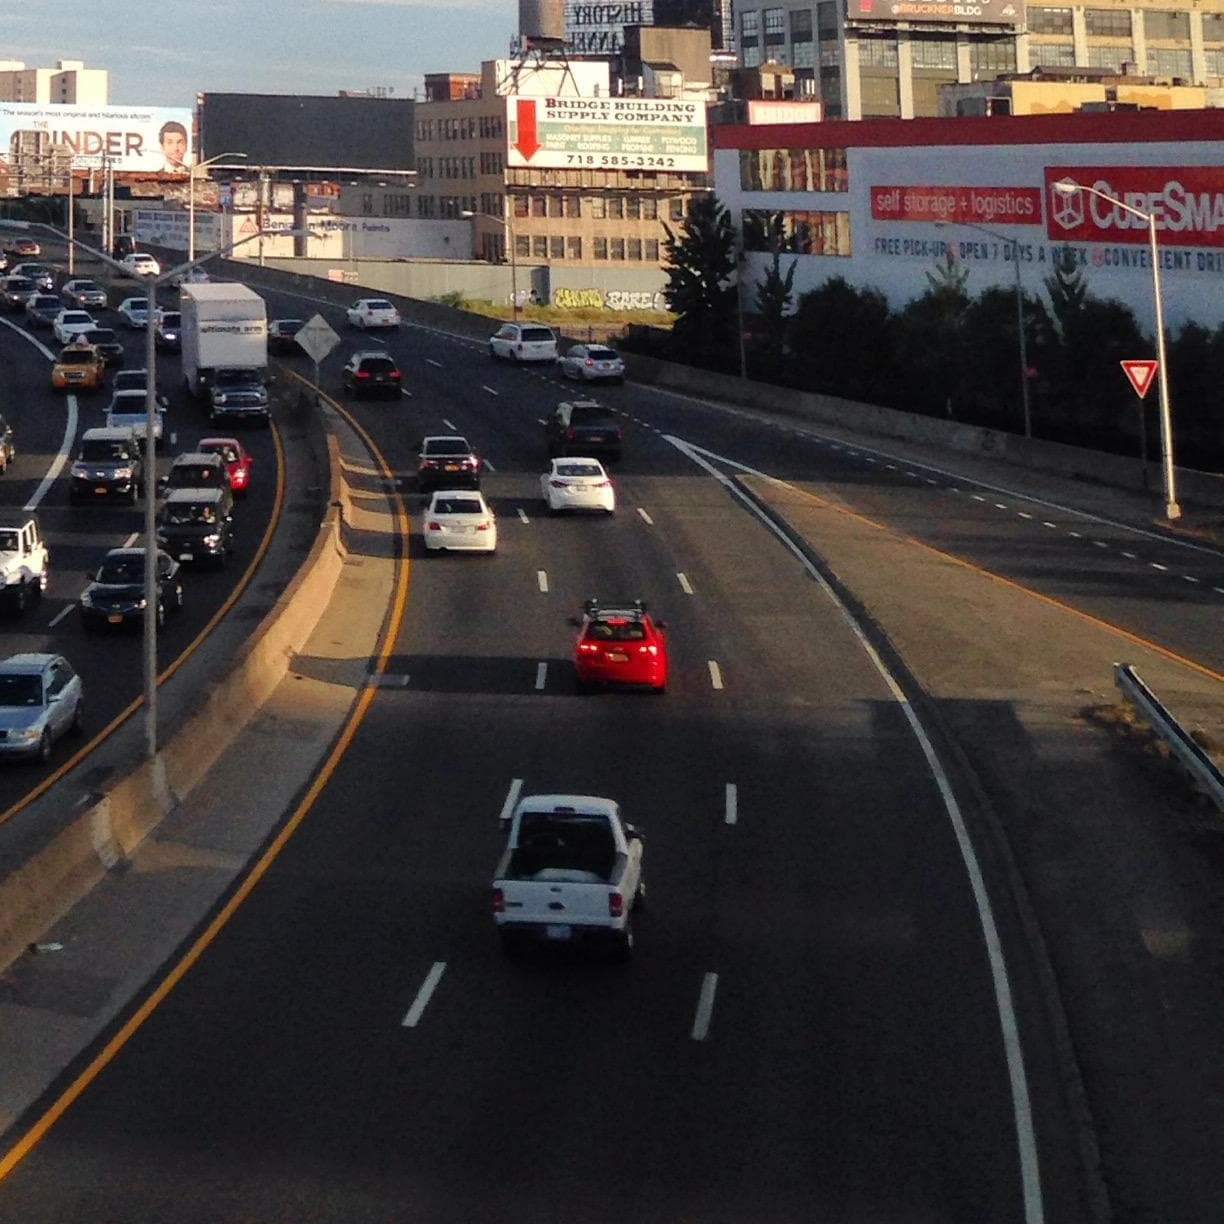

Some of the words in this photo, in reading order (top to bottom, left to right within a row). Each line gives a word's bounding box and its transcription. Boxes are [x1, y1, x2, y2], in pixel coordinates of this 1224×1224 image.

[891, 4, 982, 16] @BRUCKNERBLDG
[544, 97, 611, 111] BRIDGE
[614, 99, 696, 113] BUILDING
[45, 110, 61, 118] most
[63, 110, 88, 120] original
[88, 111, 101, 119] and
[102, 111, 129, 120] hilarious
[546, 110, 610, 121] SUPPLY
[614, 111, 695, 123] COMPANY
[566, 154, 594, 164] 718
[601, 155, 675, 167] 585-3242
[876, 189, 900, 212] self
[904, 192, 956, 218] storage
[971, 190, 1034, 220] logistics
[875, 237, 900, 256] FREE
[903, 239, 947, 258] PICK-UP
[959, 242, 988, 260] OPEN
[992, 242, 998, 260] 7
[1003, 243, 1033, 262] DAYS
[1038, 246, 1047, 263] A
